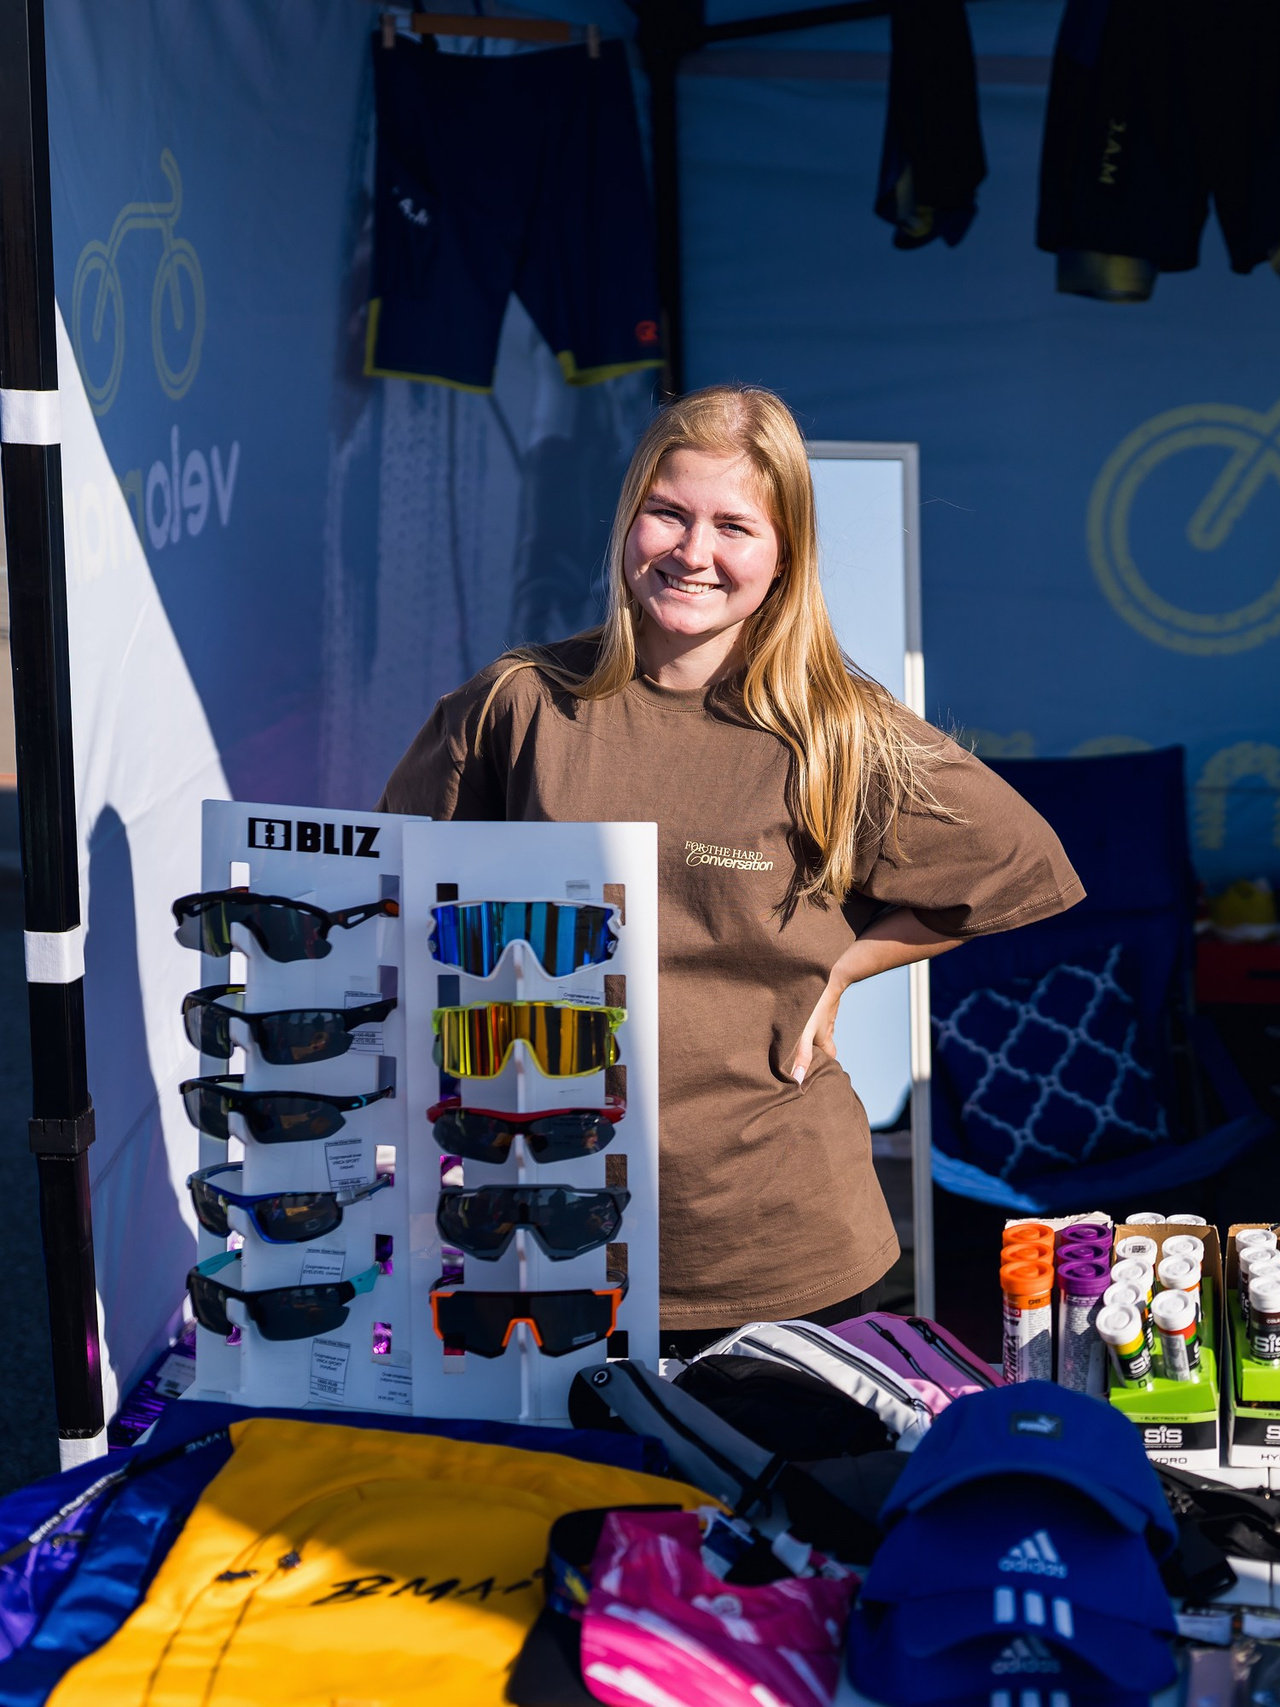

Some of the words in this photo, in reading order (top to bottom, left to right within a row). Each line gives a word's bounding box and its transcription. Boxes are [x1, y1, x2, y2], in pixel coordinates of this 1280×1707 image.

[297, 820, 381, 859] BLIZ
[685, 841, 706, 852] FOR
[708, 844, 731, 857] THE
[732, 849, 764, 861] HARD
[686, 845, 773, 871] Conversation
[1144, 1425, 1183, 1444] SiS
[1151, 1457, 1188, 1466] YDRO
